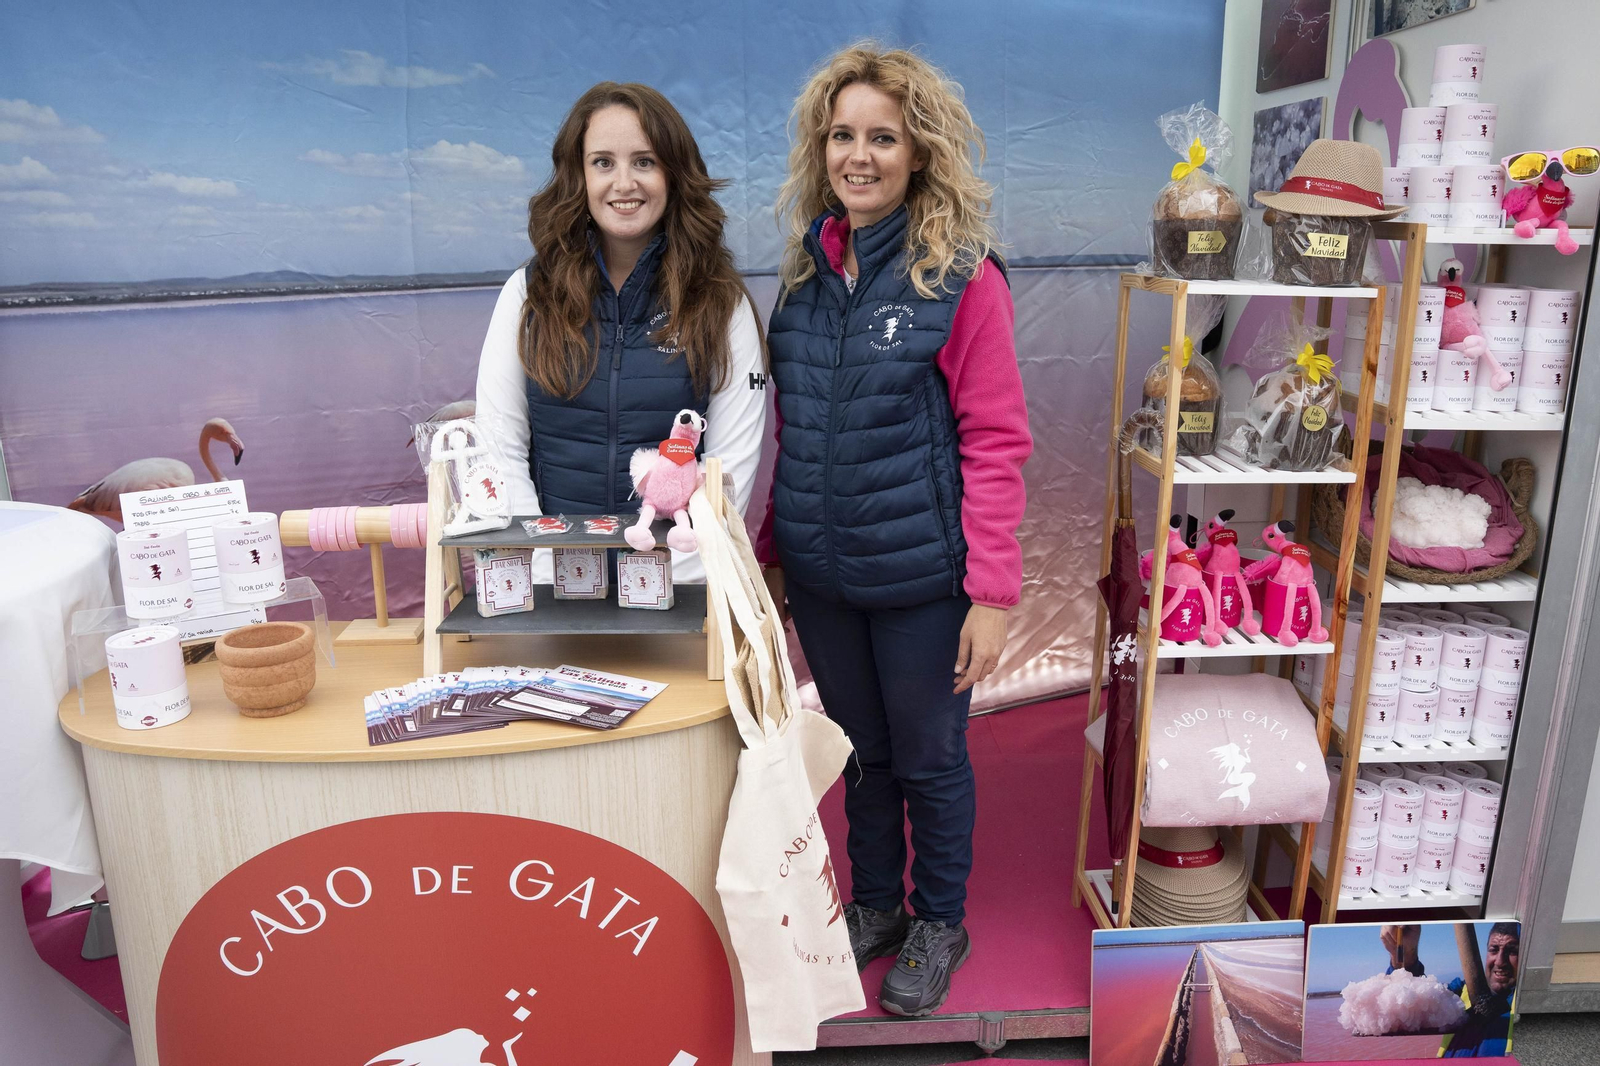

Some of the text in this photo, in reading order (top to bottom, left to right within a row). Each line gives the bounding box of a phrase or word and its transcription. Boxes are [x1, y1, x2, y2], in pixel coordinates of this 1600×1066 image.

[1197, 233, 1214, 245] Feliz
[1318, 236, 1340, 248] Feliz
[1190, 243, 1221, 252] Navidad
[1311, 247, 1345, 257] Navidad
[873, 304, 893, 317] CABO
[902, 305, 915, 317] GATA
[650, 311, 667, 325] CABO
[869, 341, 882, 351] FLOR
[892, 340, 903, 348] SAL
[1311, 408, 1320, 417] Feliz
[1191, 414, 1207, 424] Feliz
[1304, 416, 1324, 425] Navidad
[464, 467, 478, 484] CABO
[486, 464, 499, 474] GATA
[182, 491, 200, 499] CABO
[214, 486, 231, 494] GATA
[230, 538, 249, 546] CABO
[257, 534, 272, 543] GATA
[130, 551, 150, 560] CABO
[158, 549, 176, 558] GATA
[582, 674, 628, 686] Salinas
[165, 701, 179, 712] FLOR
[1164, 708, 1289, 741] CABO DE GATA
[779, 812, 818, 878] CABO DE
[218, 859, 660, 977] CABO DE GATA
[826, 955, 834, 965] Y
